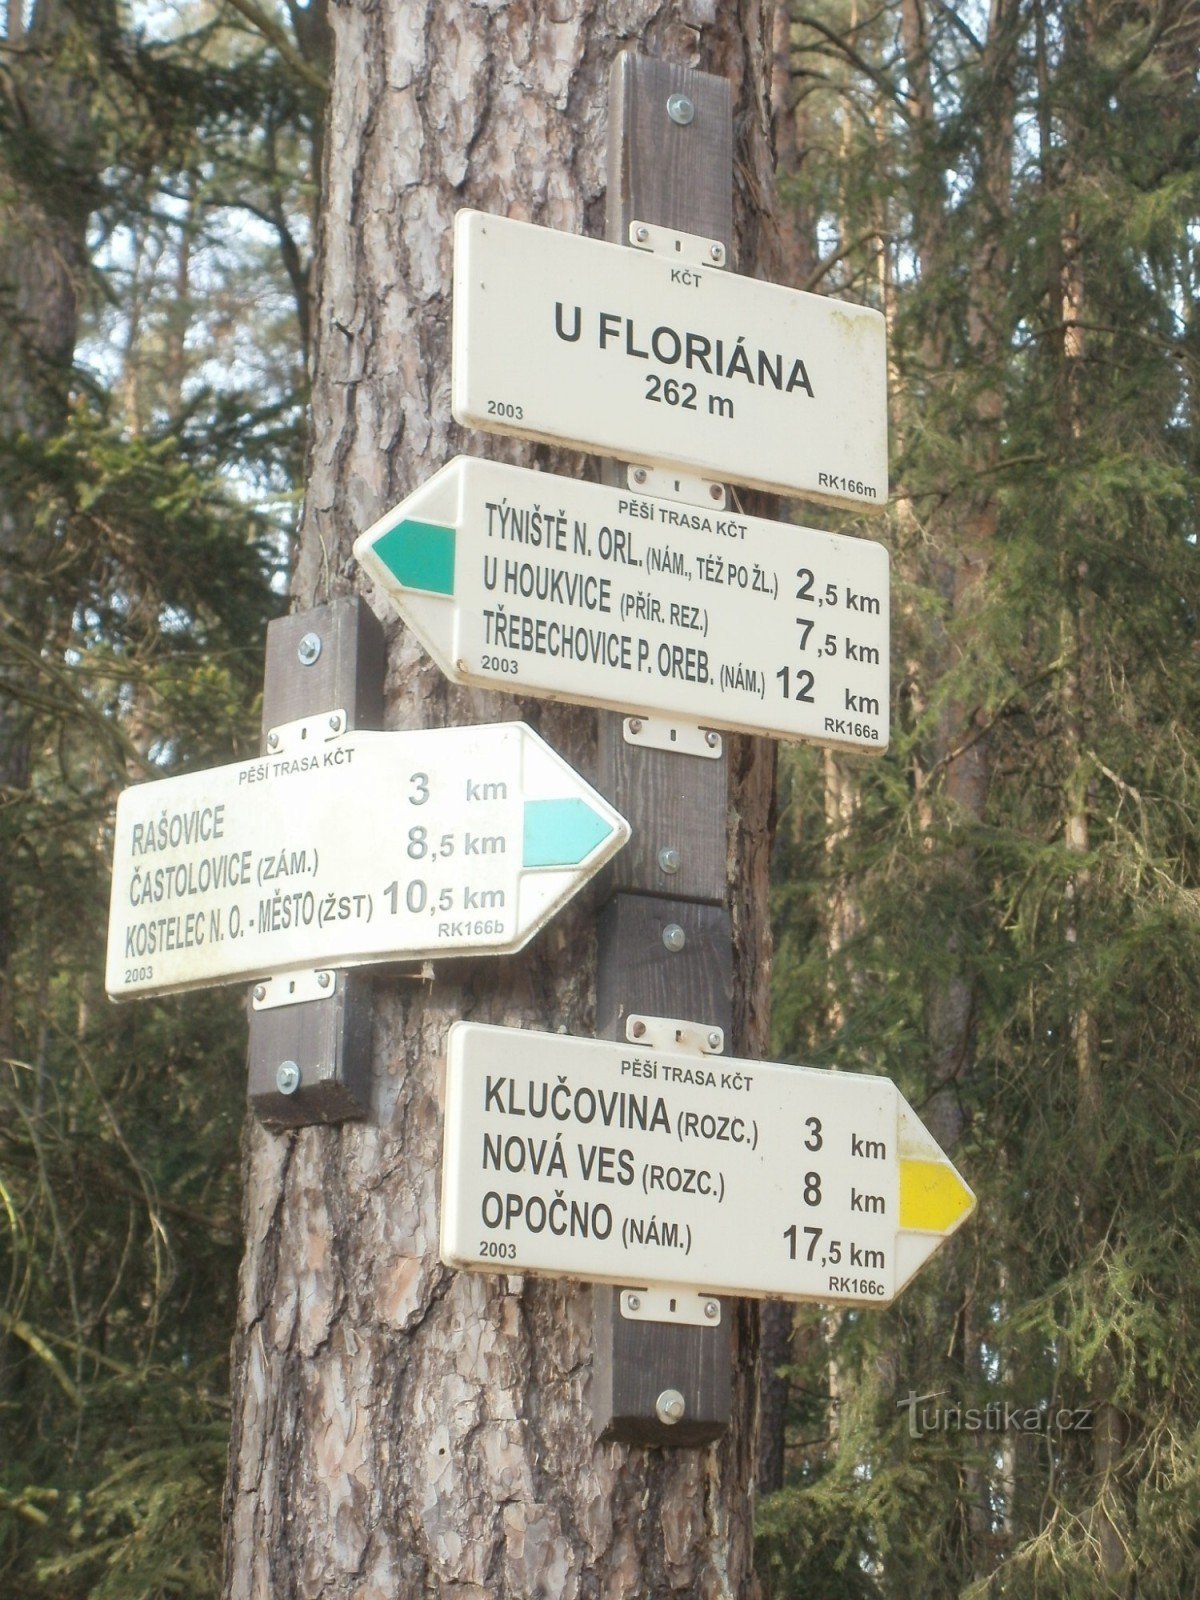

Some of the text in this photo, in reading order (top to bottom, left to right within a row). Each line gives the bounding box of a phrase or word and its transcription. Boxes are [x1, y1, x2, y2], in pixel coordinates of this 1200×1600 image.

[671, 269, 702, 287] KČT
[555, 302, 814, 397] U FLORIÁNA
[488, 401, 523, 420] 2003
[645, 375, 734, 418] 262 m
[818, 472, 876, 498] RK166m
[619, 500, 747, 539] PĚŠÍ TRASA KČT
[485, 500, 568, 552] TÝNIŠTĚ
[599, 526, 643, 567] ORL.
[697, 553, 725, 585] TÉŽ
[796, 569, 838, 606] 2,5
[847, 583, 880, 614] km
[484, 556, 879, 664] U HOUKVICE (PŘÍR. REZ.) 7,5 km
[482, 655, 519, 675] 2003
[484, 605, 879, 715] TŘEBECHOVICE P. OREB. (NÁM.) 12 km
[824, 717, 879, 739] RK166a
[239, 748, 355, 785] PĚŠÍ TRASA KČT
[132, 773, 507, 856] RAŠOVICE 3 km
[130, 826, 505, 906] ČASTOLOVICE (ZÁM.) 8,5 km
[125, 917, 205, 957] KOSTELEC
[258, 888, 314, 933] MĚSTO
[383, 879, 454, 916] 10,5
[465, 886, 505, 908] km
[438, 919, 503, 938] RK166b
[125, 966, 153, 984] 2003
[621, 1060, 753, 1091] PĚŠÍ TRASA KČT
[485, 1075, 886, 1159] KLUČOVINA (ROZC.) 3 km
[483, 1133, 885, 1214] NOVÁ VES (ROZC.) 8 km
[482, 1189, 885, 1268] OPOČNO (NÁM.) 17,5 km
[479, 1241, 516, 1259] 2003
[829, 1277, 885, 1296] RK166c
